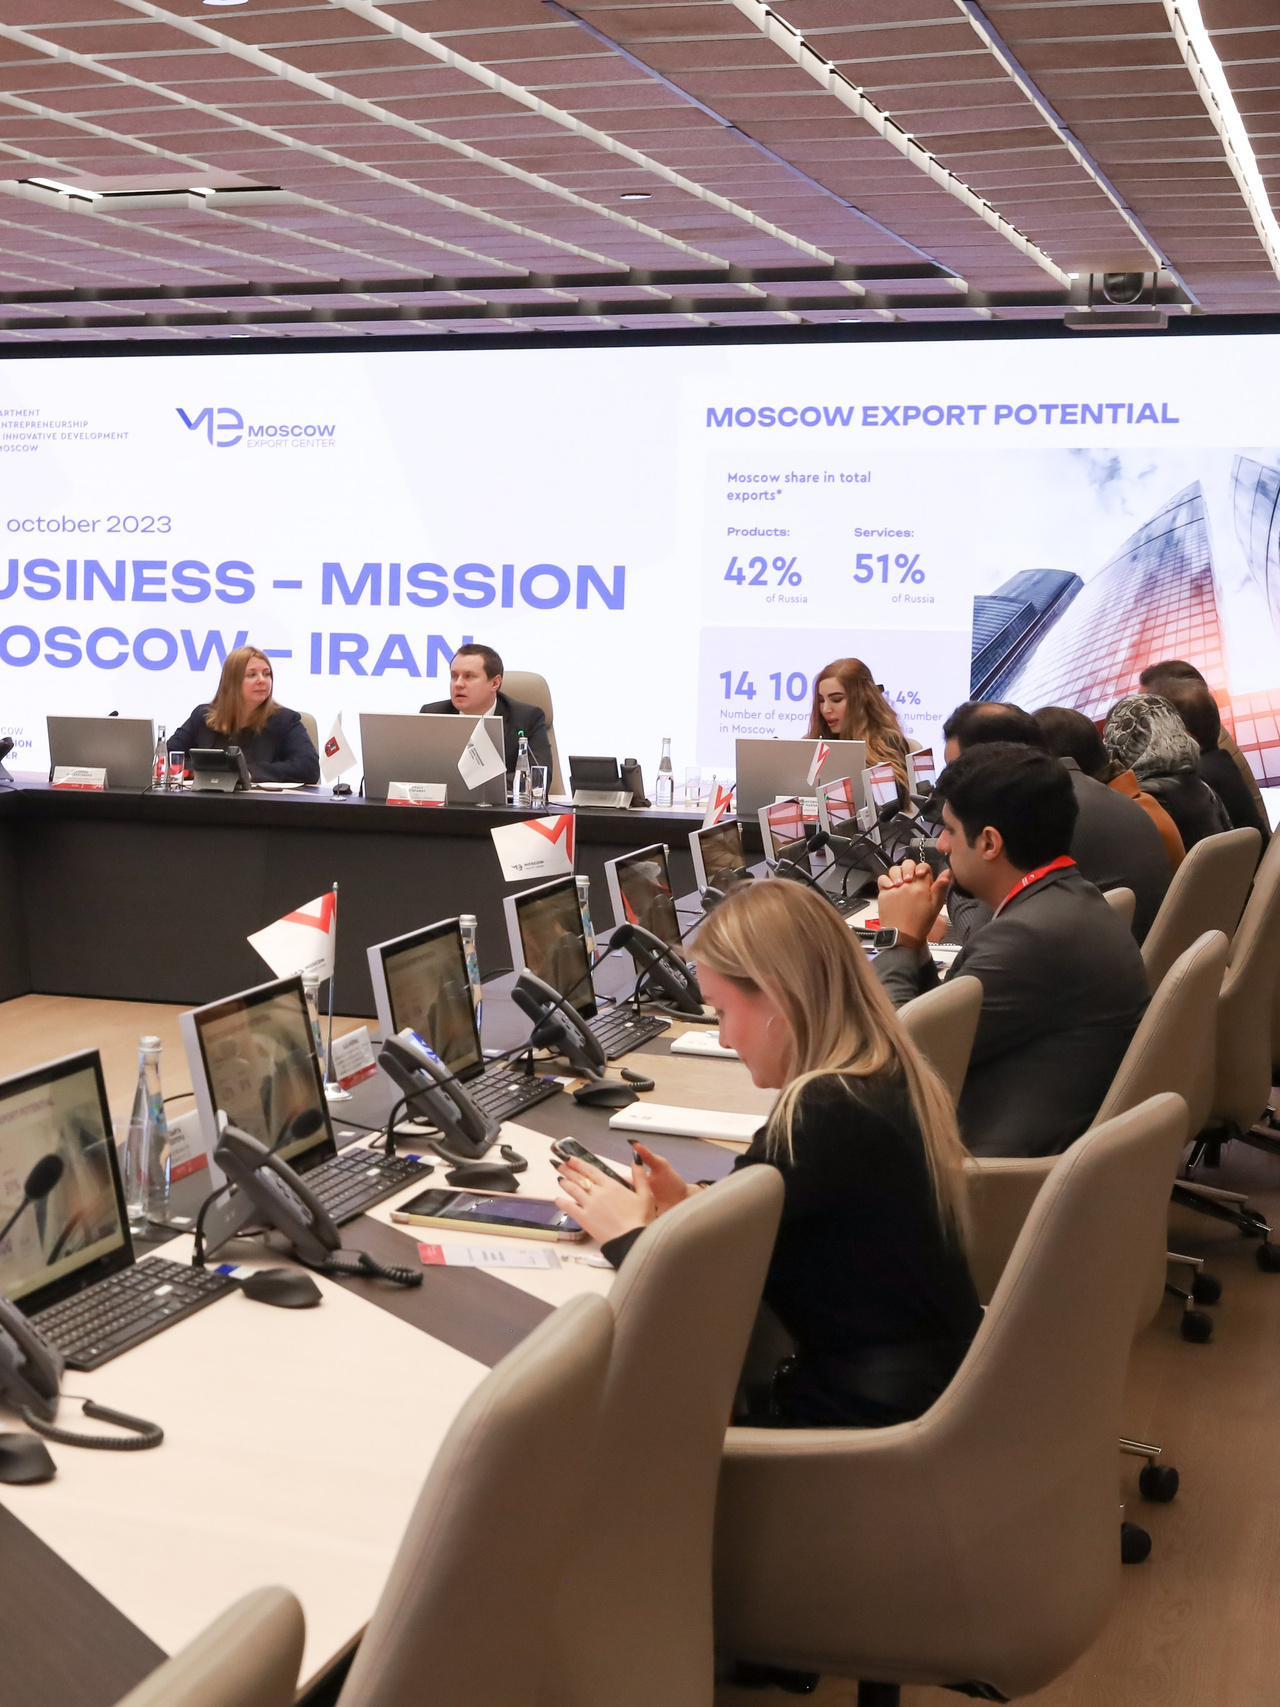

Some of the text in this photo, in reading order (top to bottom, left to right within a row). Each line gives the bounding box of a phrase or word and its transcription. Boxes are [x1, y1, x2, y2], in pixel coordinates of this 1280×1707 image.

[706, 402, 1180, 428] MOSCOW EXPORT POTENTIAL
[2, 432, 58, 440] INNOVATIVE
[60, 432, 129, 440] DEVELOPMENT
[248, 425, 336, 437] MOSCOW
[247, 439, 336, 448] EXPORT CENTER
[727, 471, 871, 483] Moscow share in total
[6, 515, 101, 533] october
[106, 515, 172, 533] 2023
[727, 527, 790, 537] Products:
[854, 527, 915, 538] Services:
[723, 555, 803, 587] 42%
[852, 553, 926, 584] 51%
[321, 562, 626, 610] MISSION
[765, 593, 808, 604] of Russia
[891, 593, 935, 604] of Russia
[719, 670, 819, 702] 14 10
[720, 709, 762, 720] Number
[764, 709, 776, 720] of
[904, 711, 942, 721] number
[719, 724, 776, 734] in Moscow
